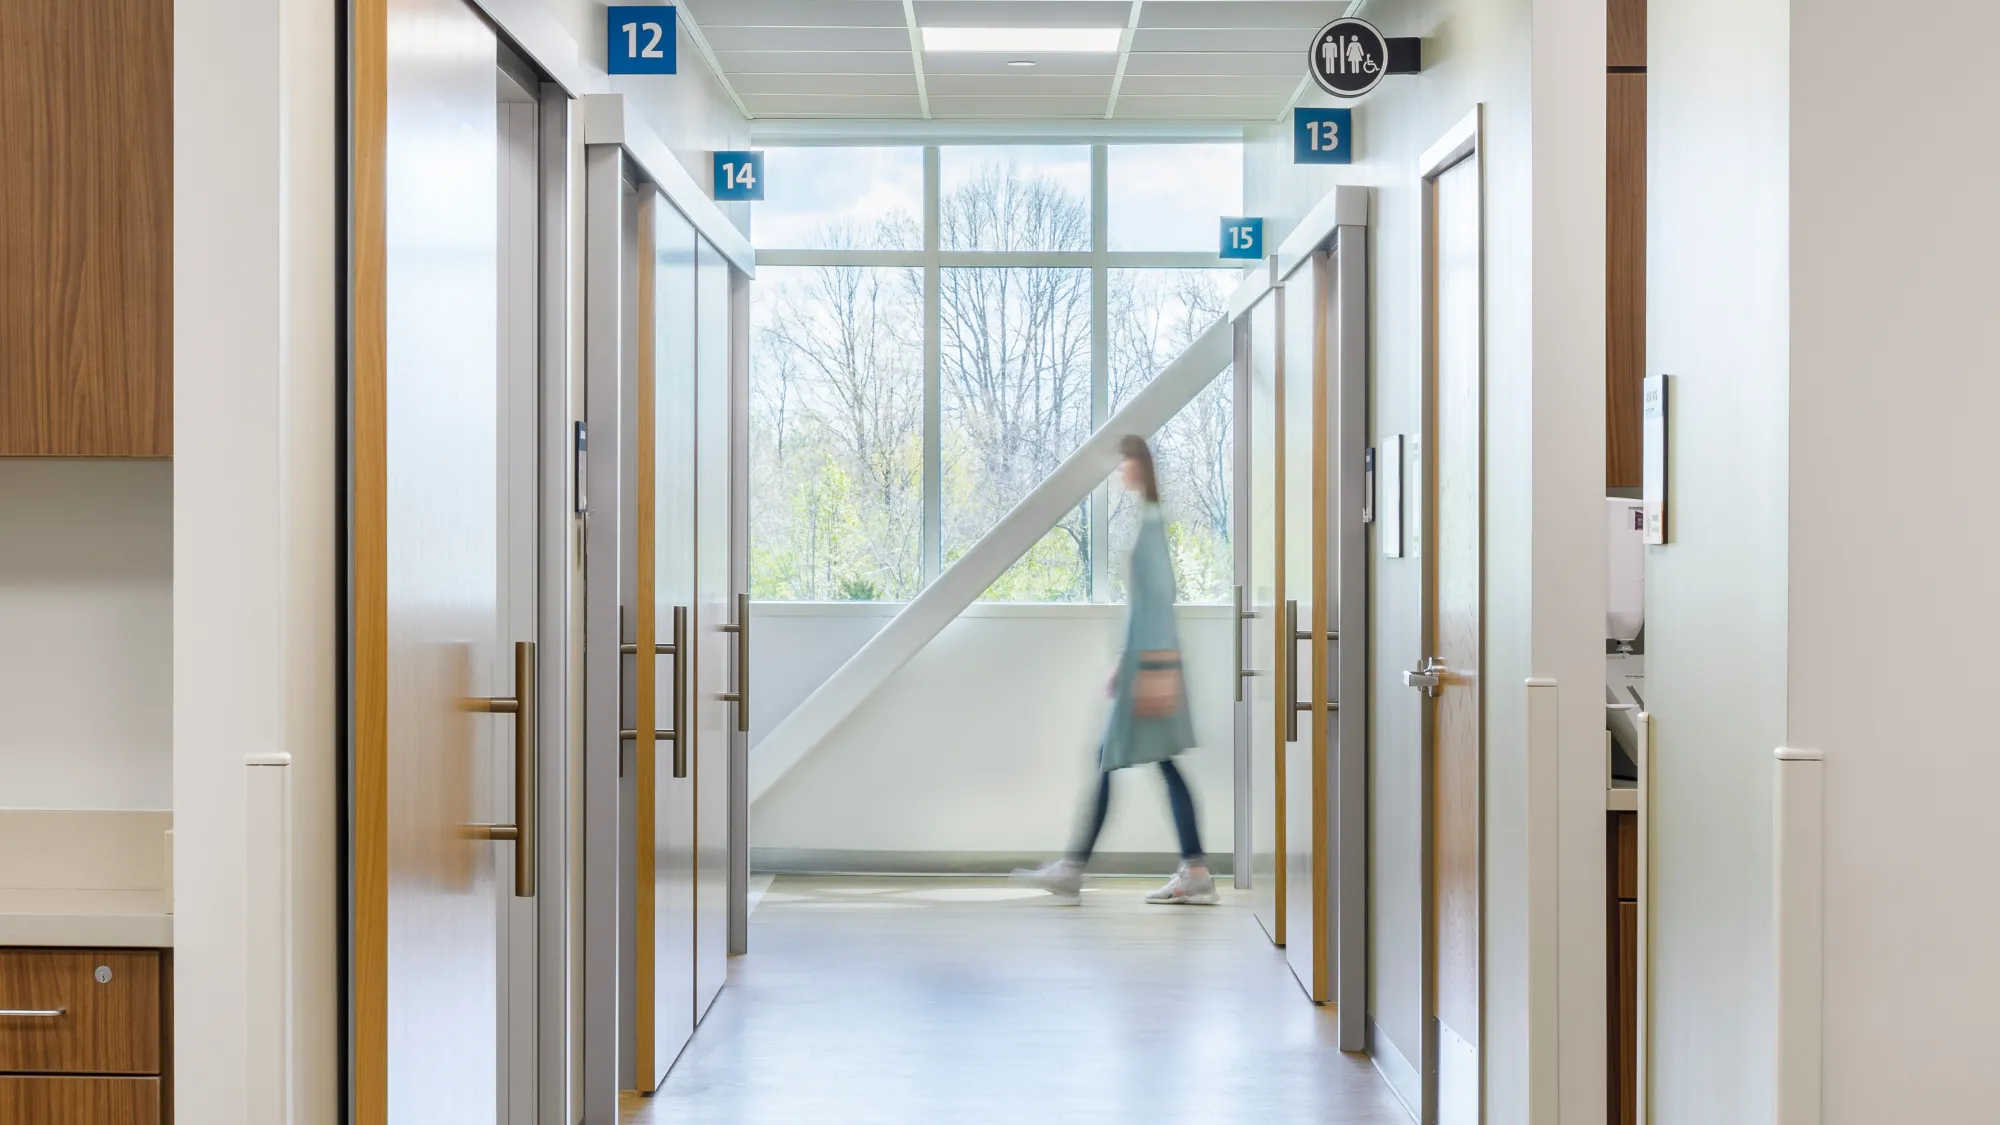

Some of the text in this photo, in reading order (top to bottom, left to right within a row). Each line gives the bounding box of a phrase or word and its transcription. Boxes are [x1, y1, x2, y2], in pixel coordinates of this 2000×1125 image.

[622, 22, 664, 58] 12
[1306, 121, 1339, 151] 13
[722, 162, 756, 190] 14
[1228, 226, 1253, 249] 15
